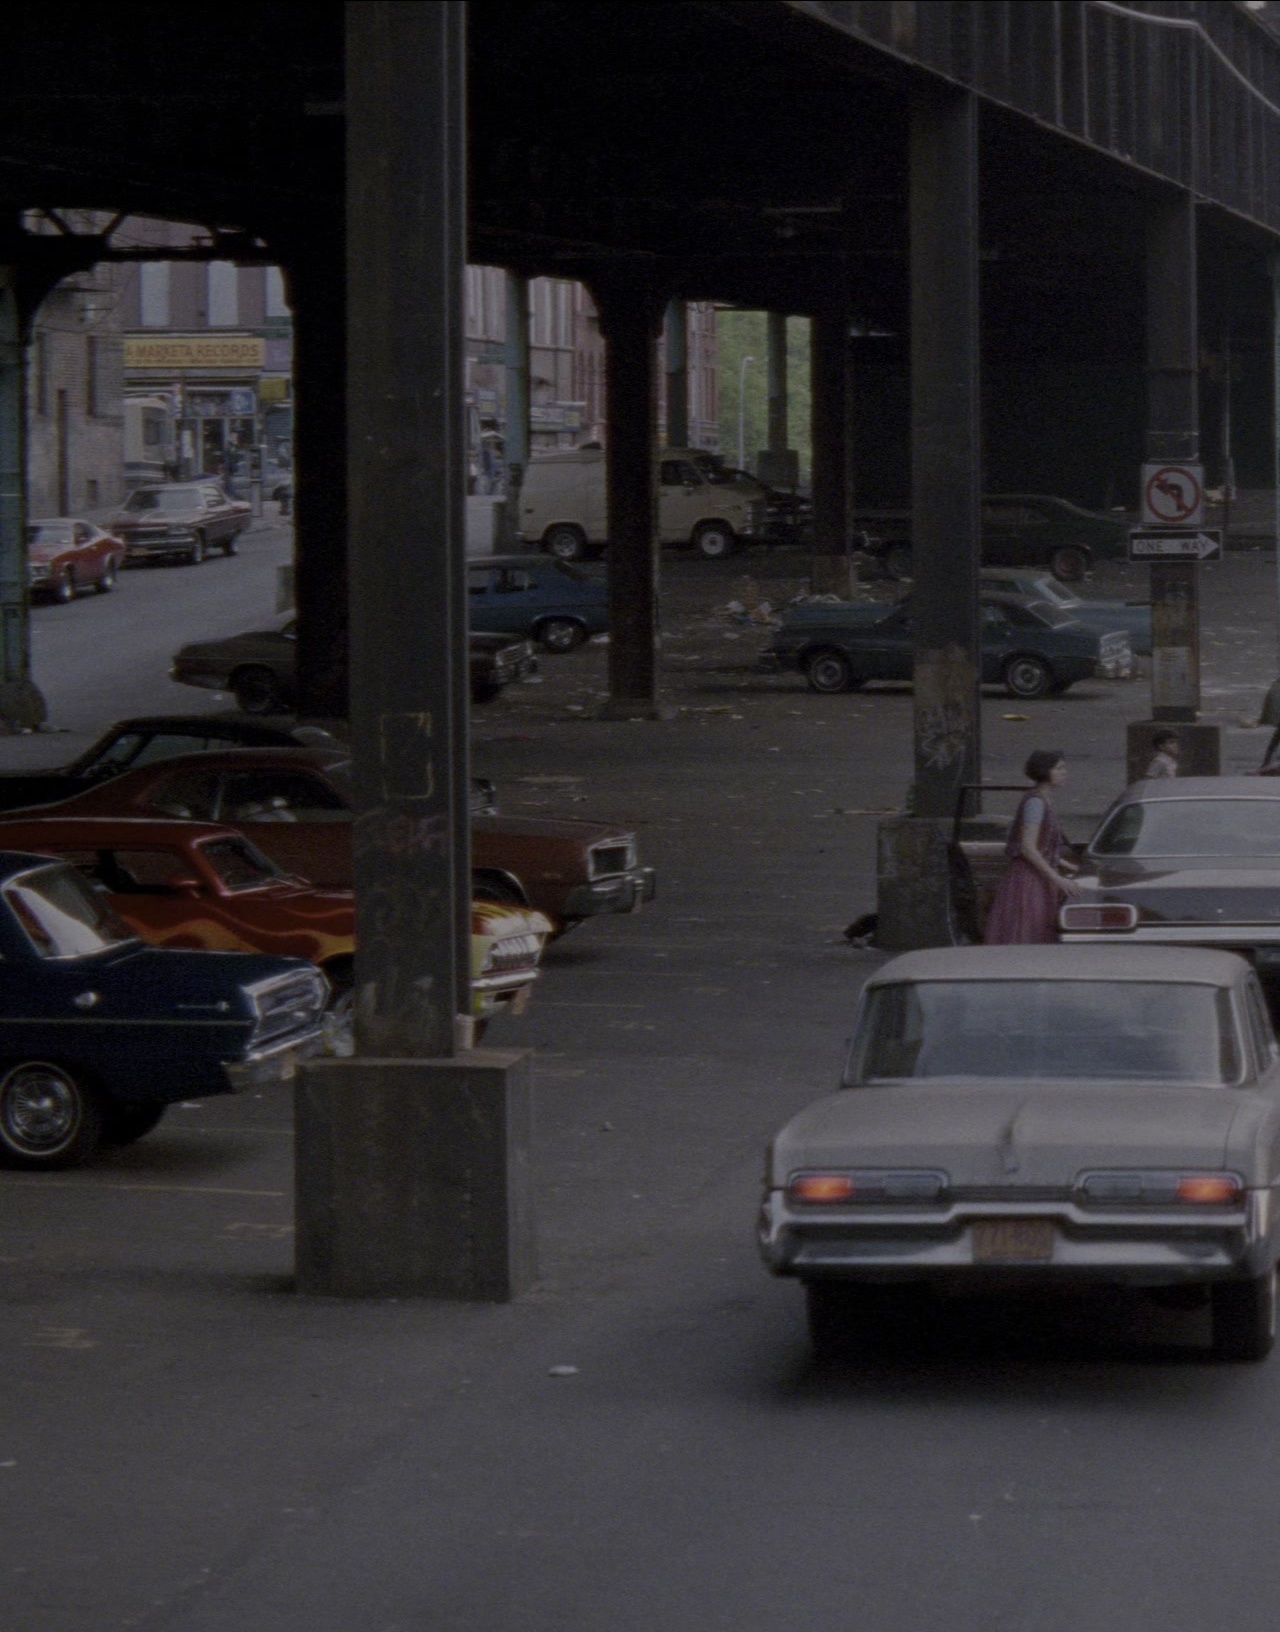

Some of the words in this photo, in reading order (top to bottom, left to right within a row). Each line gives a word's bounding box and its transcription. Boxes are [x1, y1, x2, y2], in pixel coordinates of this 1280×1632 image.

[197, 344, 260, 359] RECORDS
[1136, 540, 1162, 553] ONE
[1181, 540, 1208, 551] WAY
